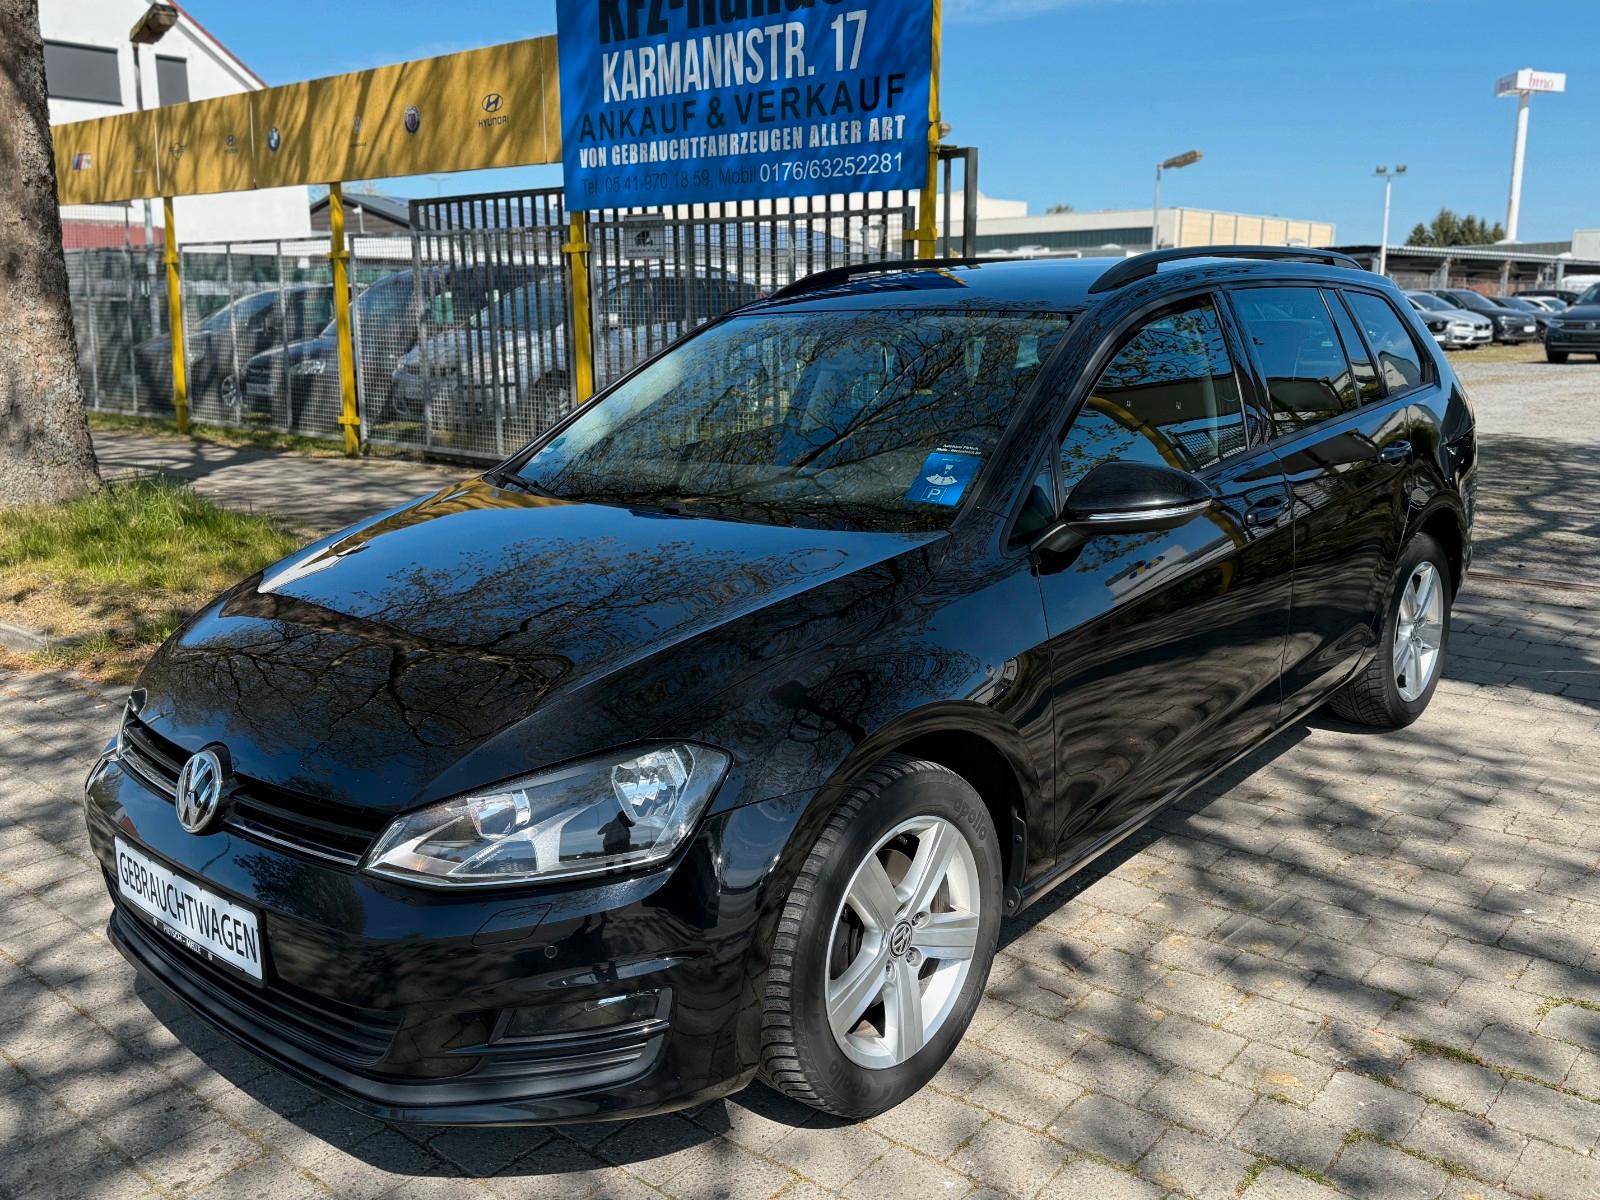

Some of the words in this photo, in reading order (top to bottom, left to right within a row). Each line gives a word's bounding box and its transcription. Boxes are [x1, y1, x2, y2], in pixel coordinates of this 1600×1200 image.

[602, 22, 814, 103] KARMANNSTR.
[831, 10, 867, 72] 17
[579, 100, 697, 143] ANKAUF
[707, 97, 724, 129] &
[734, 73, 906, 125] VERKAUF
[580, 147, 607, 169] VON
[611, 126, 803, 167] GEBRAUCHTFAHRZEUGEN
[809, 120, 862, 148] ALLER
[869, 115, 906, 142] ART
[605, 176, 621, 194] 05
[623, 172, 668, 193] 41-970
[674, 170, 689, 189] 18
[759, 151, 903, 183] 0176/63252281
[119, 851, 258, 963] GEBRAUCHTWAGEN
